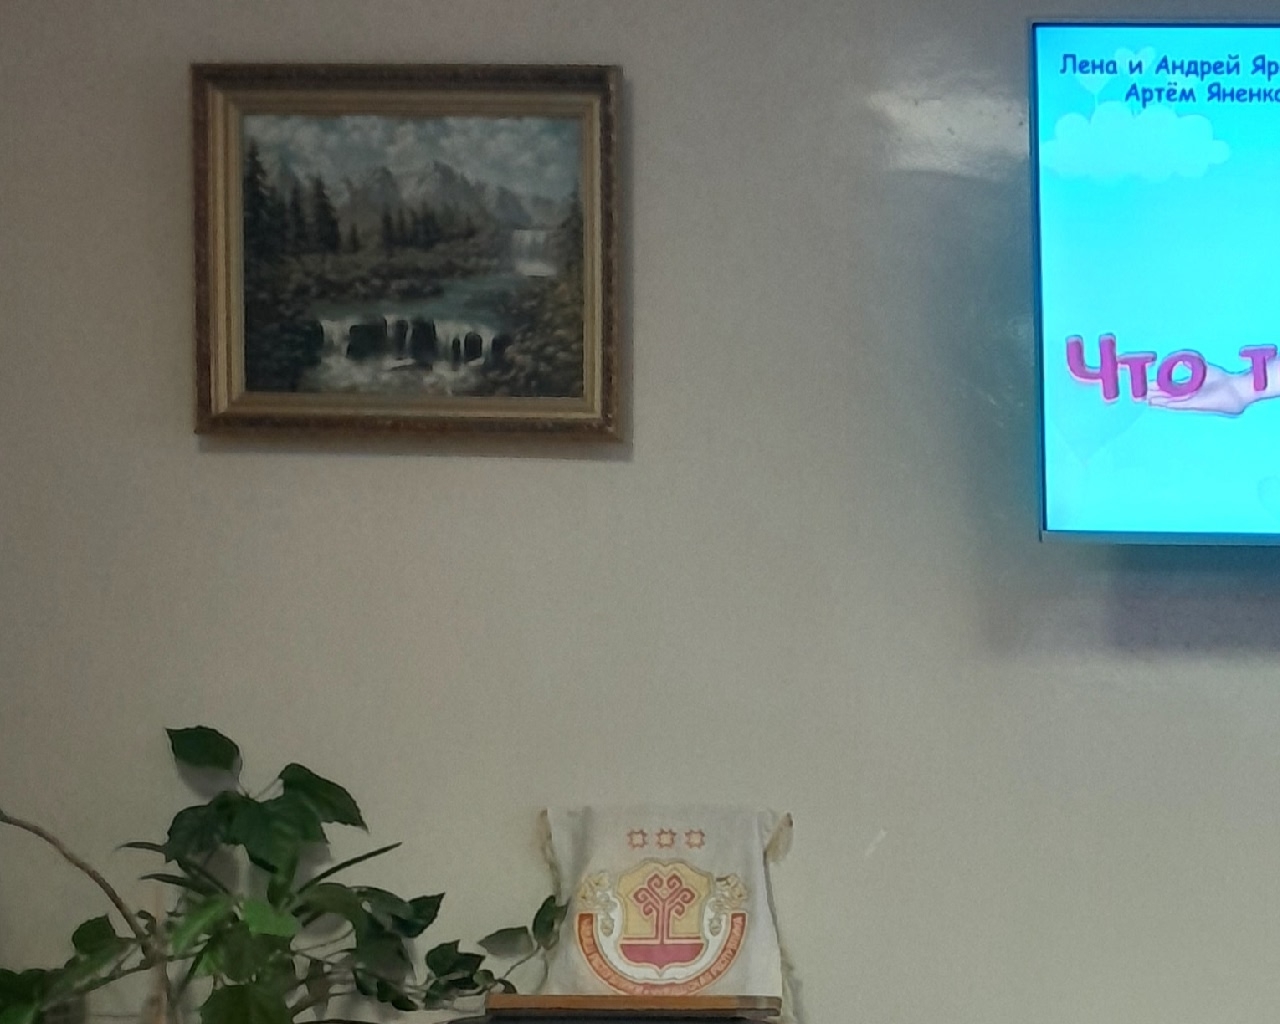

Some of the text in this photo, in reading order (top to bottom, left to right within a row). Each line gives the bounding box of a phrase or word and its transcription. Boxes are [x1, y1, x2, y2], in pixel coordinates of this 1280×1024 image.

[1060, 54, 1118, 75] Лена
[1129, 59, 1143, 75] и
[1155, 54, 1241, 81] Андрей
[1125, 82, 1196, 109] Артём
[1066, 333, 1206, 403] Что
